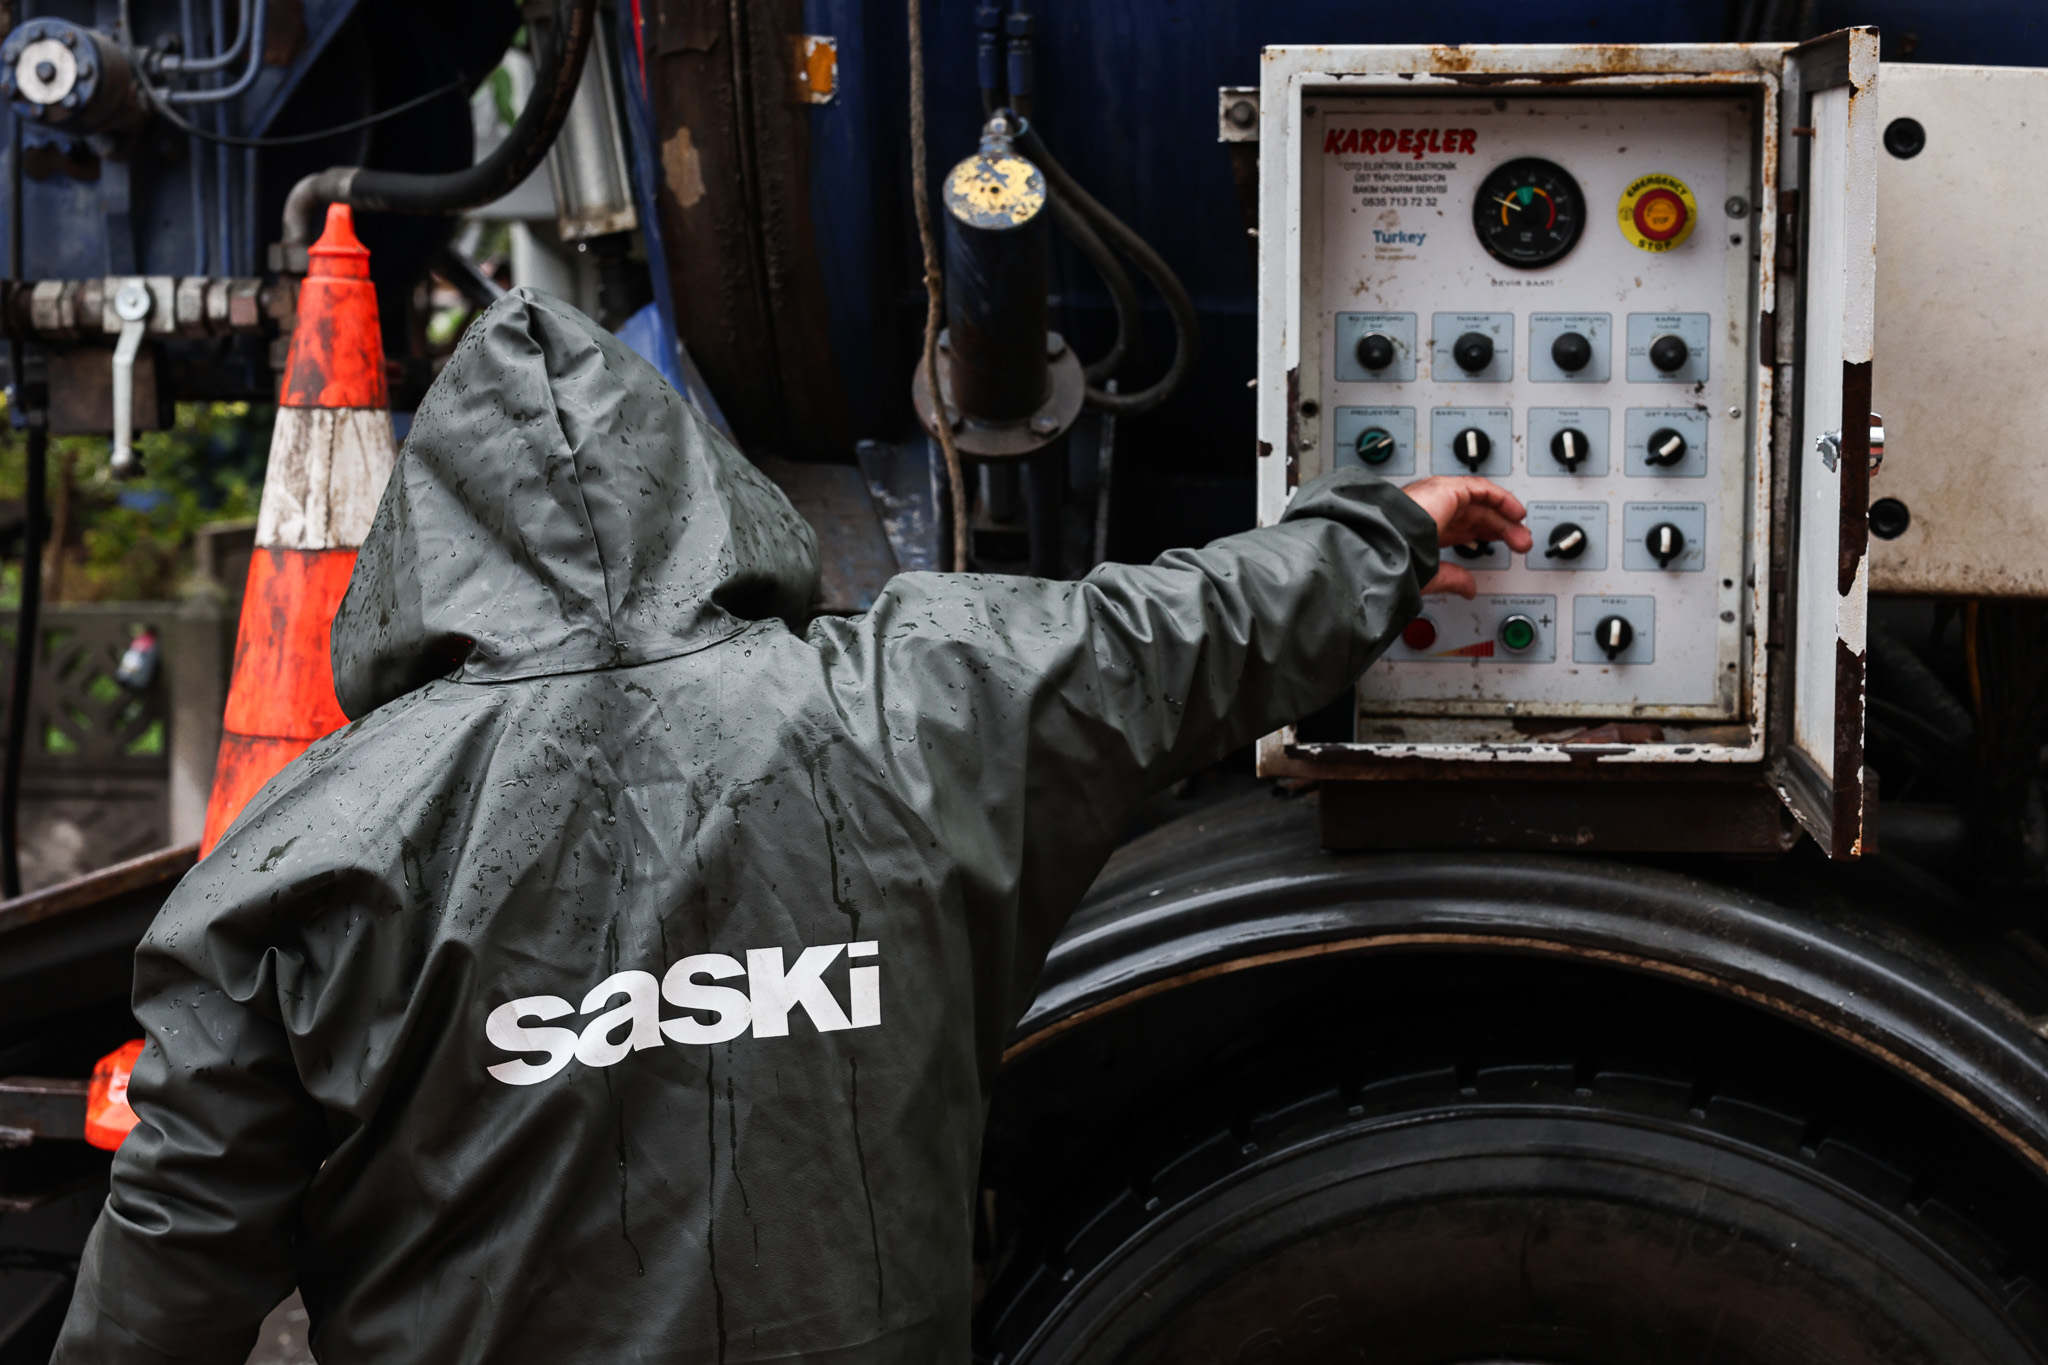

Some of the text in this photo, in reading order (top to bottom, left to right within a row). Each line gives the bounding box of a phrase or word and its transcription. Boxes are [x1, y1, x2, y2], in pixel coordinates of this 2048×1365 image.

[1324, 127, 1478, 160] KARDEŞLER
[1626, 176, 1689, 198] EMERGENCY
[1389, 197, 1408, 207] 713
[1410, 197, 1423, 207] 72
[1425, 197, 1438, 207] 32
[1372, 230, 1428, 247] Turkey
[1638, 239, 1673, 252] STOP
